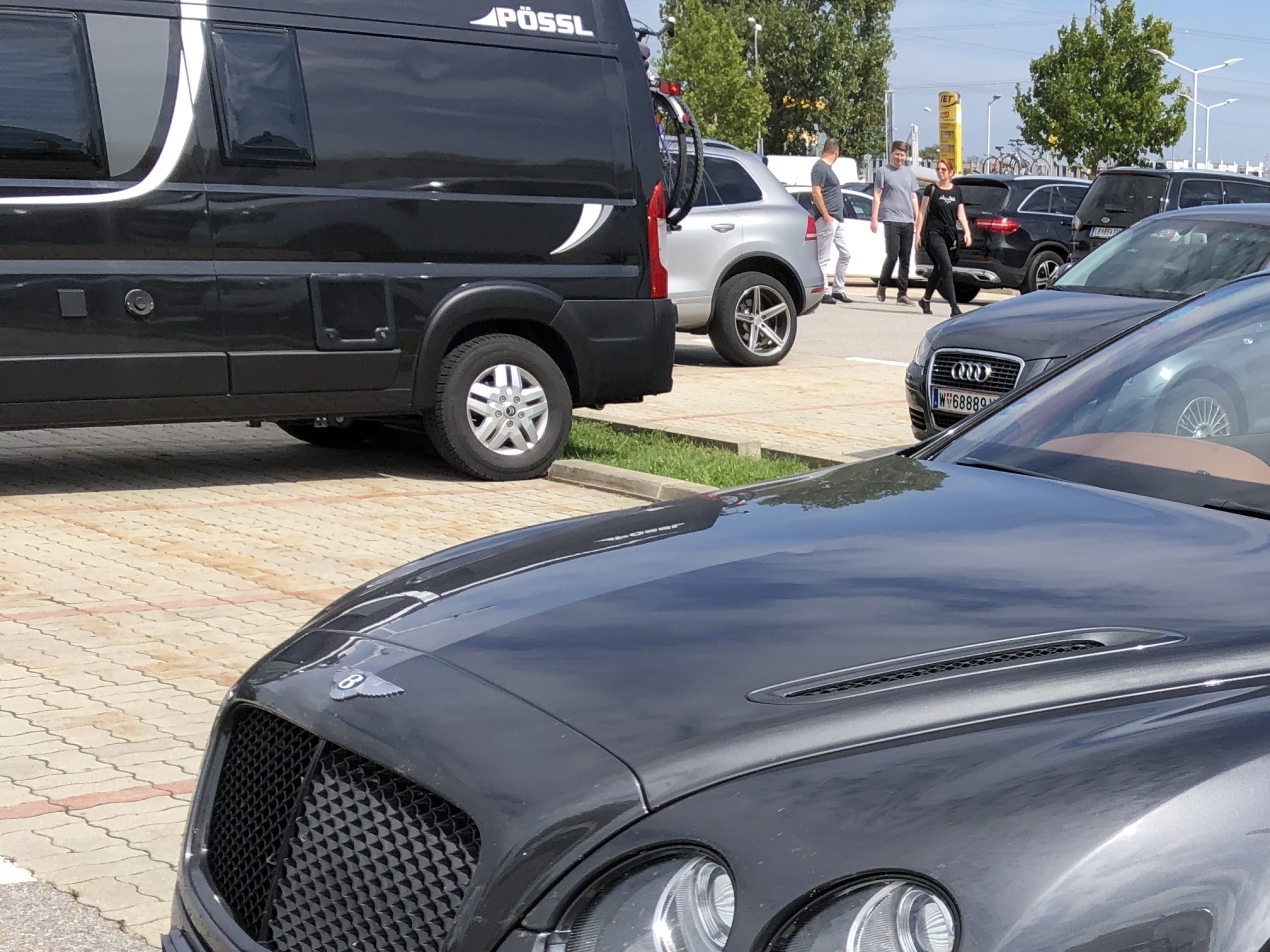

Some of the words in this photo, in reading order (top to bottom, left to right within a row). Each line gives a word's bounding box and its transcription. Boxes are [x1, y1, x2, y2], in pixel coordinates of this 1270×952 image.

[495, 5, 595, 37] PÖSSL
[940, 95, 954, 103] JET
[939, 392, 946, 408] W
